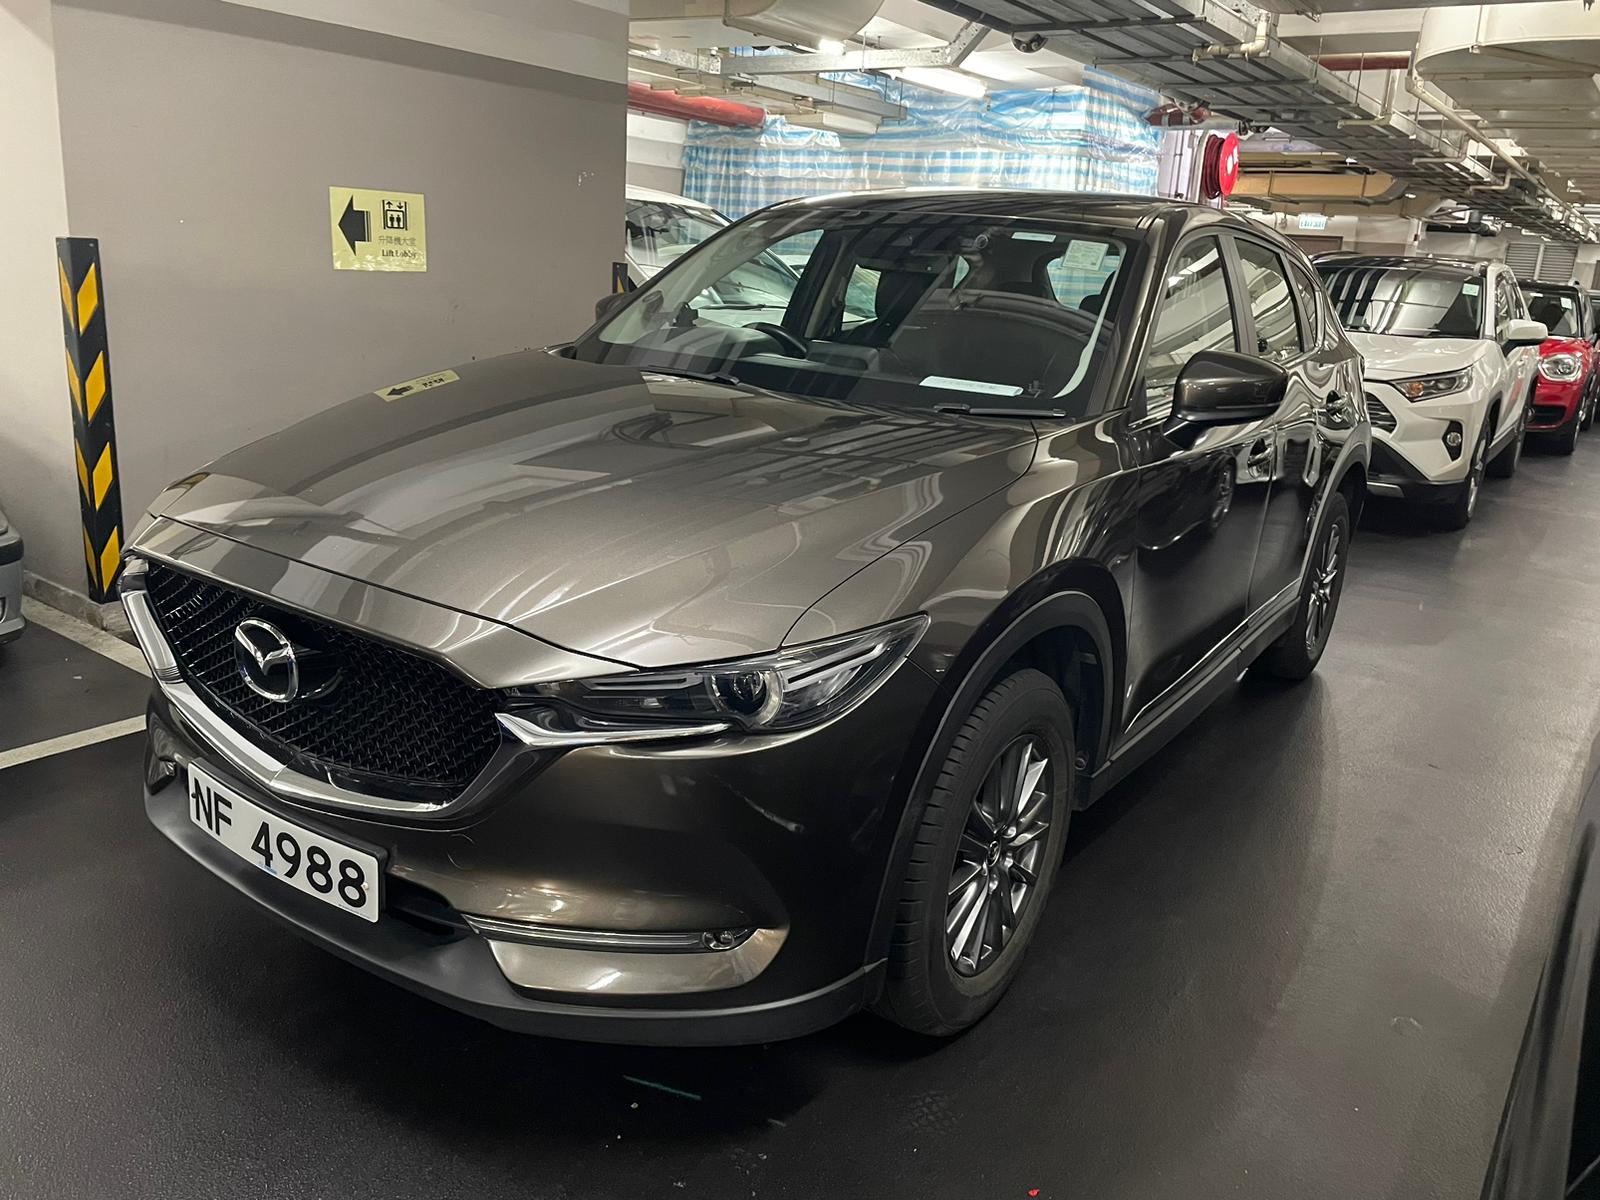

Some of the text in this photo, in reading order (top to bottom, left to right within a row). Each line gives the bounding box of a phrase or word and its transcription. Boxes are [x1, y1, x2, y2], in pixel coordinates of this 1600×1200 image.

[382, 249, 394, 257] Lift
[192, 777, 366, 908] NF 4988
